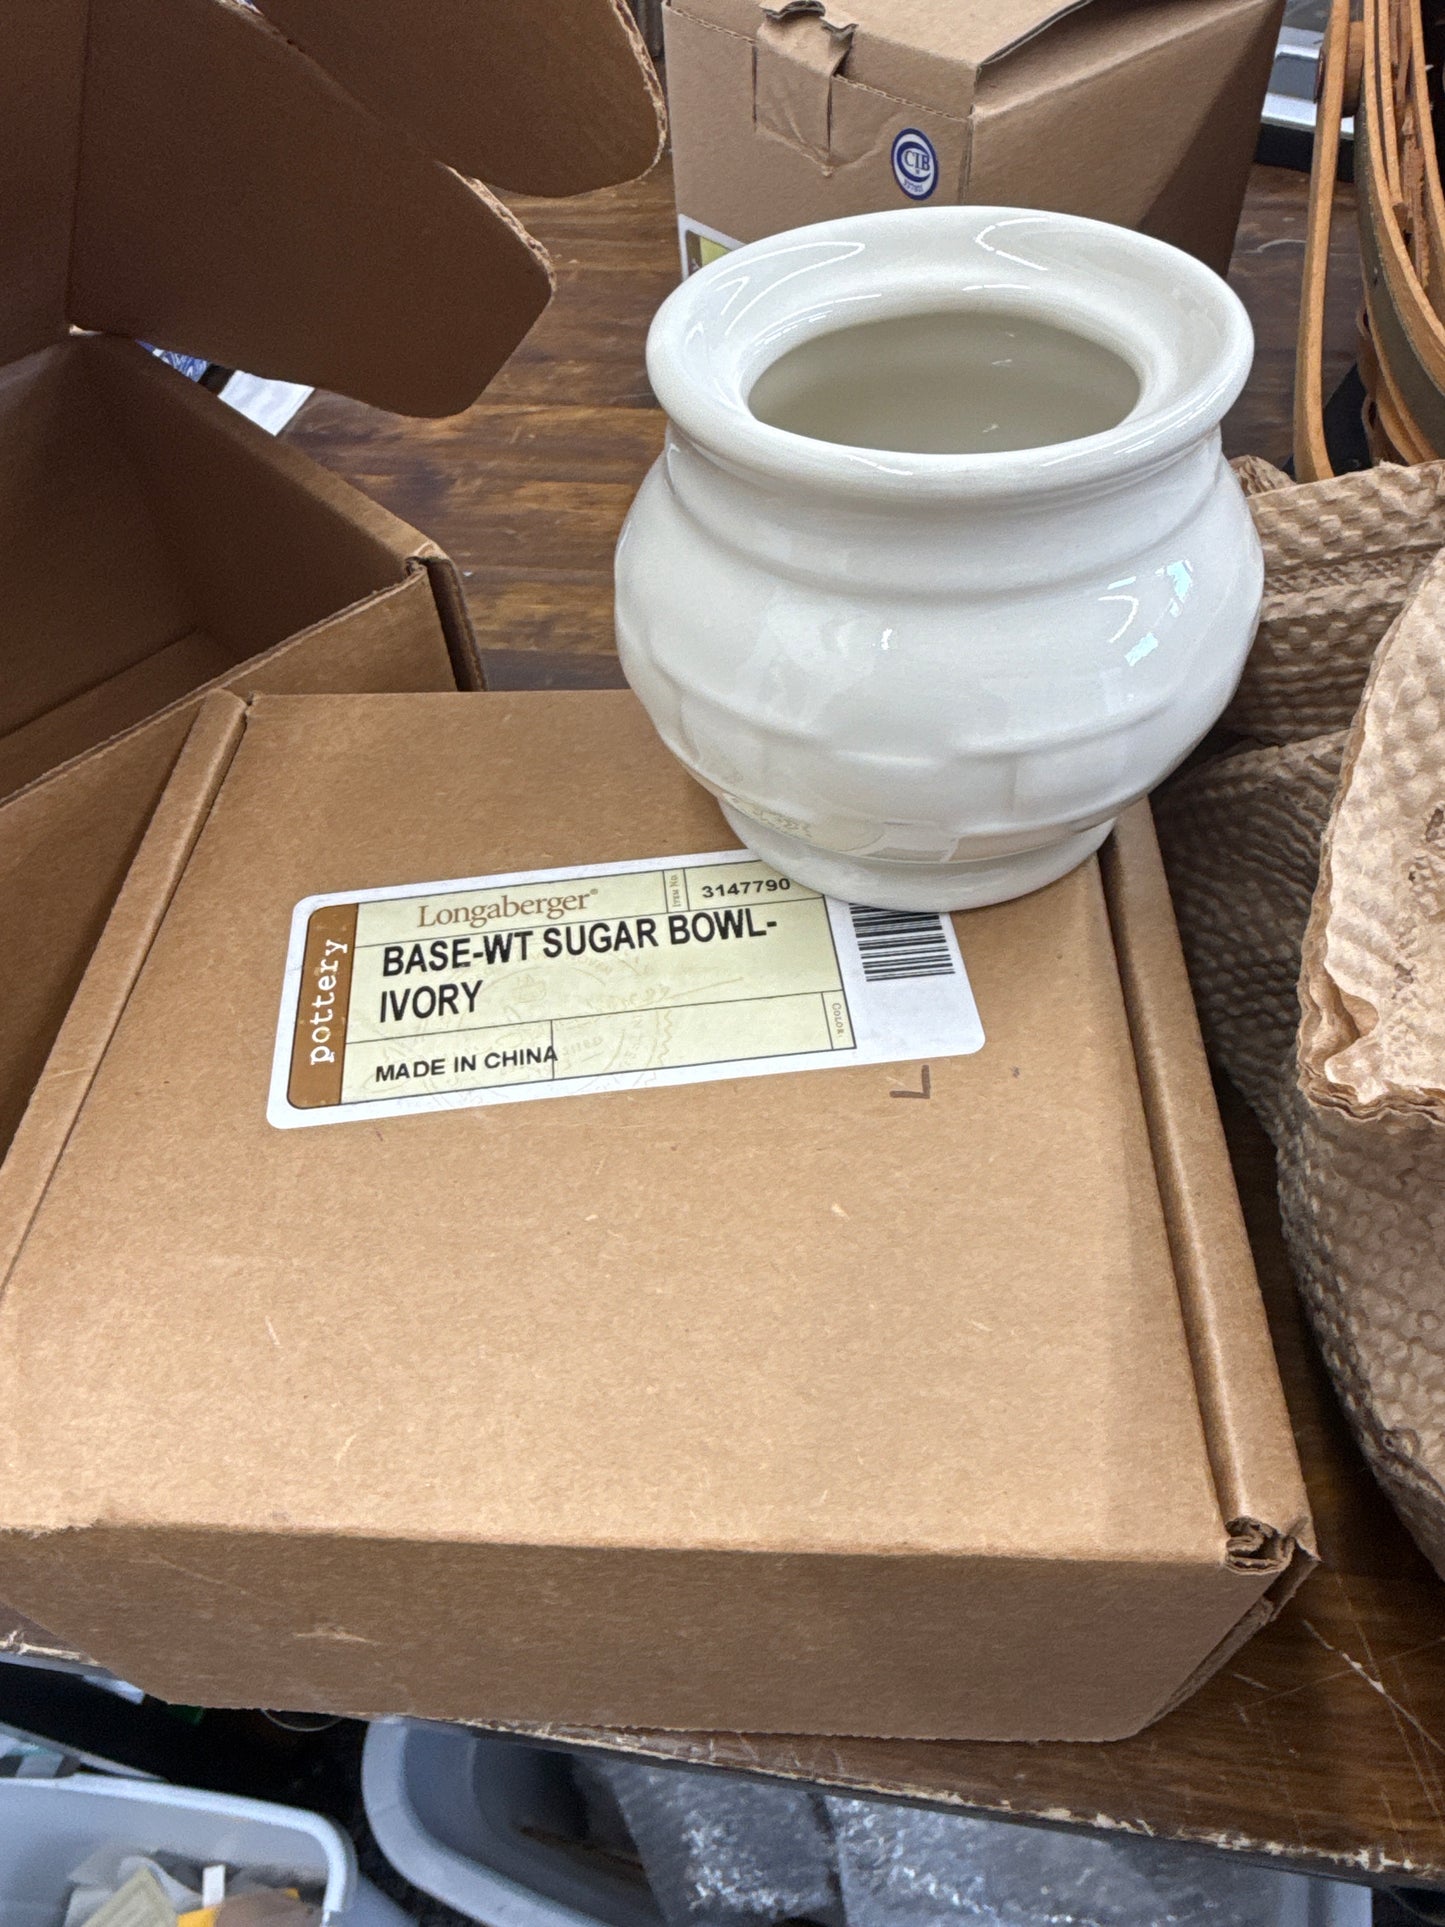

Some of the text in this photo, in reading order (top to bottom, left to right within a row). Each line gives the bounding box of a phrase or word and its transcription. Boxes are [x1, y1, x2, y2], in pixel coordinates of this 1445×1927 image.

[702, 877, 791, 899] 3147790
[383, 930, 533, 977] BASE-WT
[543, 918, 659, 959] SUGAR
[668, 908, 777, 945] BOWL-
[310, 939, 348, 1066] pottery
[380, 980, 483, 1023] IVORY
[375, 1058, 446, 1083] MADE
[454, 1054, 477, 1074] IN
[484, 1045, 558, 1070] CHINA
